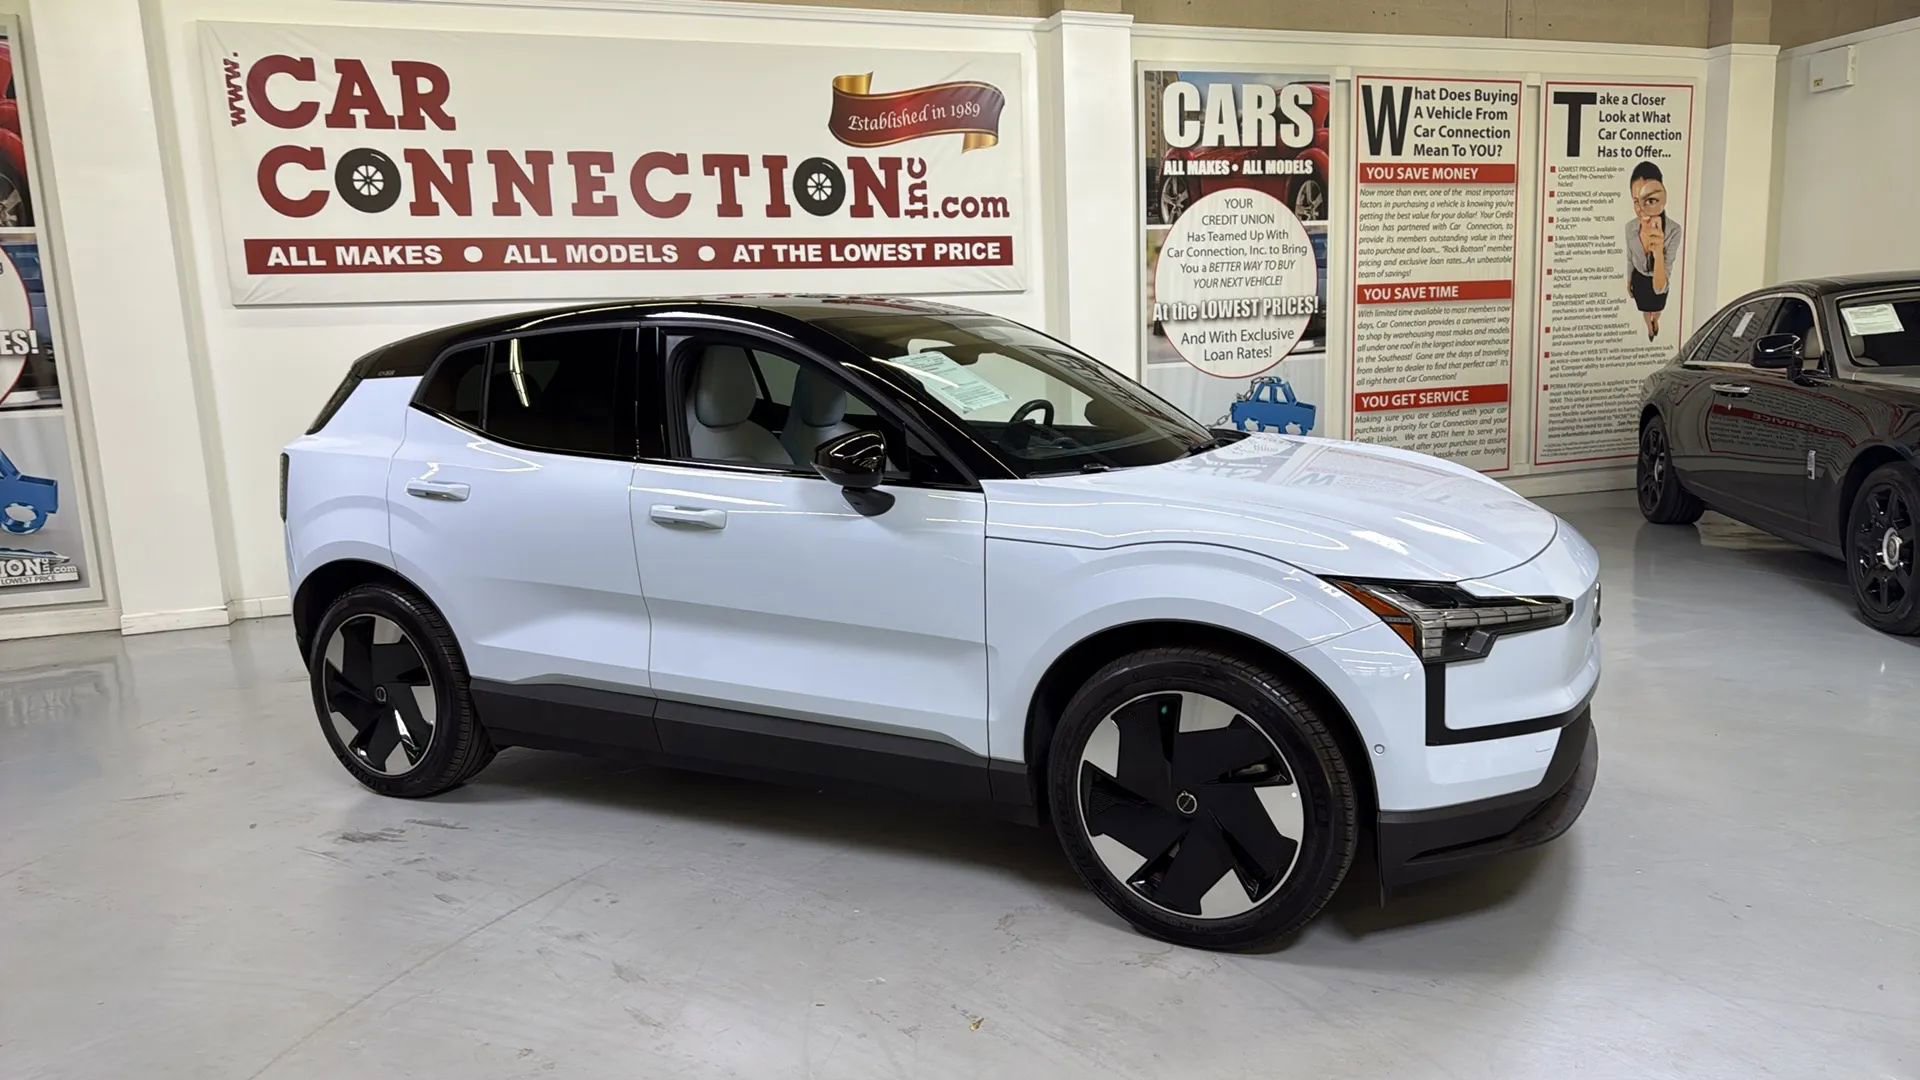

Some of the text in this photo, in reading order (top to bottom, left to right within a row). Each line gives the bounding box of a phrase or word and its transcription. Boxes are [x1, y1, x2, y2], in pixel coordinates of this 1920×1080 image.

[246, 54, 456, 131] CAR
[1440, 88, 1471, 101] Does
[1475, 89, 1518, 105] Buying
[1622, 96, 1628, 105] a
[1631, 93, 1665, 105] Closer
[847, 102, 981, 132] Established in 1989
[1163, 81, 1314, 148] CARS
[1414, 106, 1508, 120] A Vehicle From
[1599, 110, 1671, 123] Look at What
[1414, 125, 1510, 139] Car Connection
[1598, 128, 1682, 140] Car Connection
[1414, 144, 1503, 157] Mean To YOU?
[1598, 146, 1671, 157] Has to Offer...
[1164, 160, 1313, 175] ALL MAKES ALL MODELS
[1367, 167, 1478, 179] YOU SAVE MONEY
[933, 196, 1010, 218] .com
[1224, 198, 1253, 209] YOUR
[1202, 214, 1275, 225] CREDIT UNION
[1187, 230, 1288, 242] Has Teamed Up With
[266, 241, 1001, 267] ALL MAKES ALL MODELS AT THE LOWEST PRICE
[1167, 244, 1308, 258] Car Connection, Inc. to Bring
[1180, 260, 1296, 273] You a BETTER WAY TO BUY
[1194, 276, 1283, 289] YOUR NEXT VEHICLE!
[1364, 286, 1459, 300] YOU SAVE TIME
[1152, 295, 1319, 321] At the LOWEST PRICES!
[1181, 328, 1295, 345] And With Exclusive
[1204, 347, 1272, 361] Loan Rates!
[1357, 378, 1365, 386] all
[1366, 377, 1381, 387] right
[1361, 390, 1469, 408] YOU GET SERVICE
[1355, 416, 1382, 424] Making
[1402, 414, 1415, 422] you
[1432, 409, 1460, 417] satisfied
[1479, 408, 1495, 416] your
[1355, 426, 1384, 435] purchase
[1393, 424, 1417, 432] priority
[1418, 421, 1428, 429] for
[1442, 419, 1478, 427] Connection
